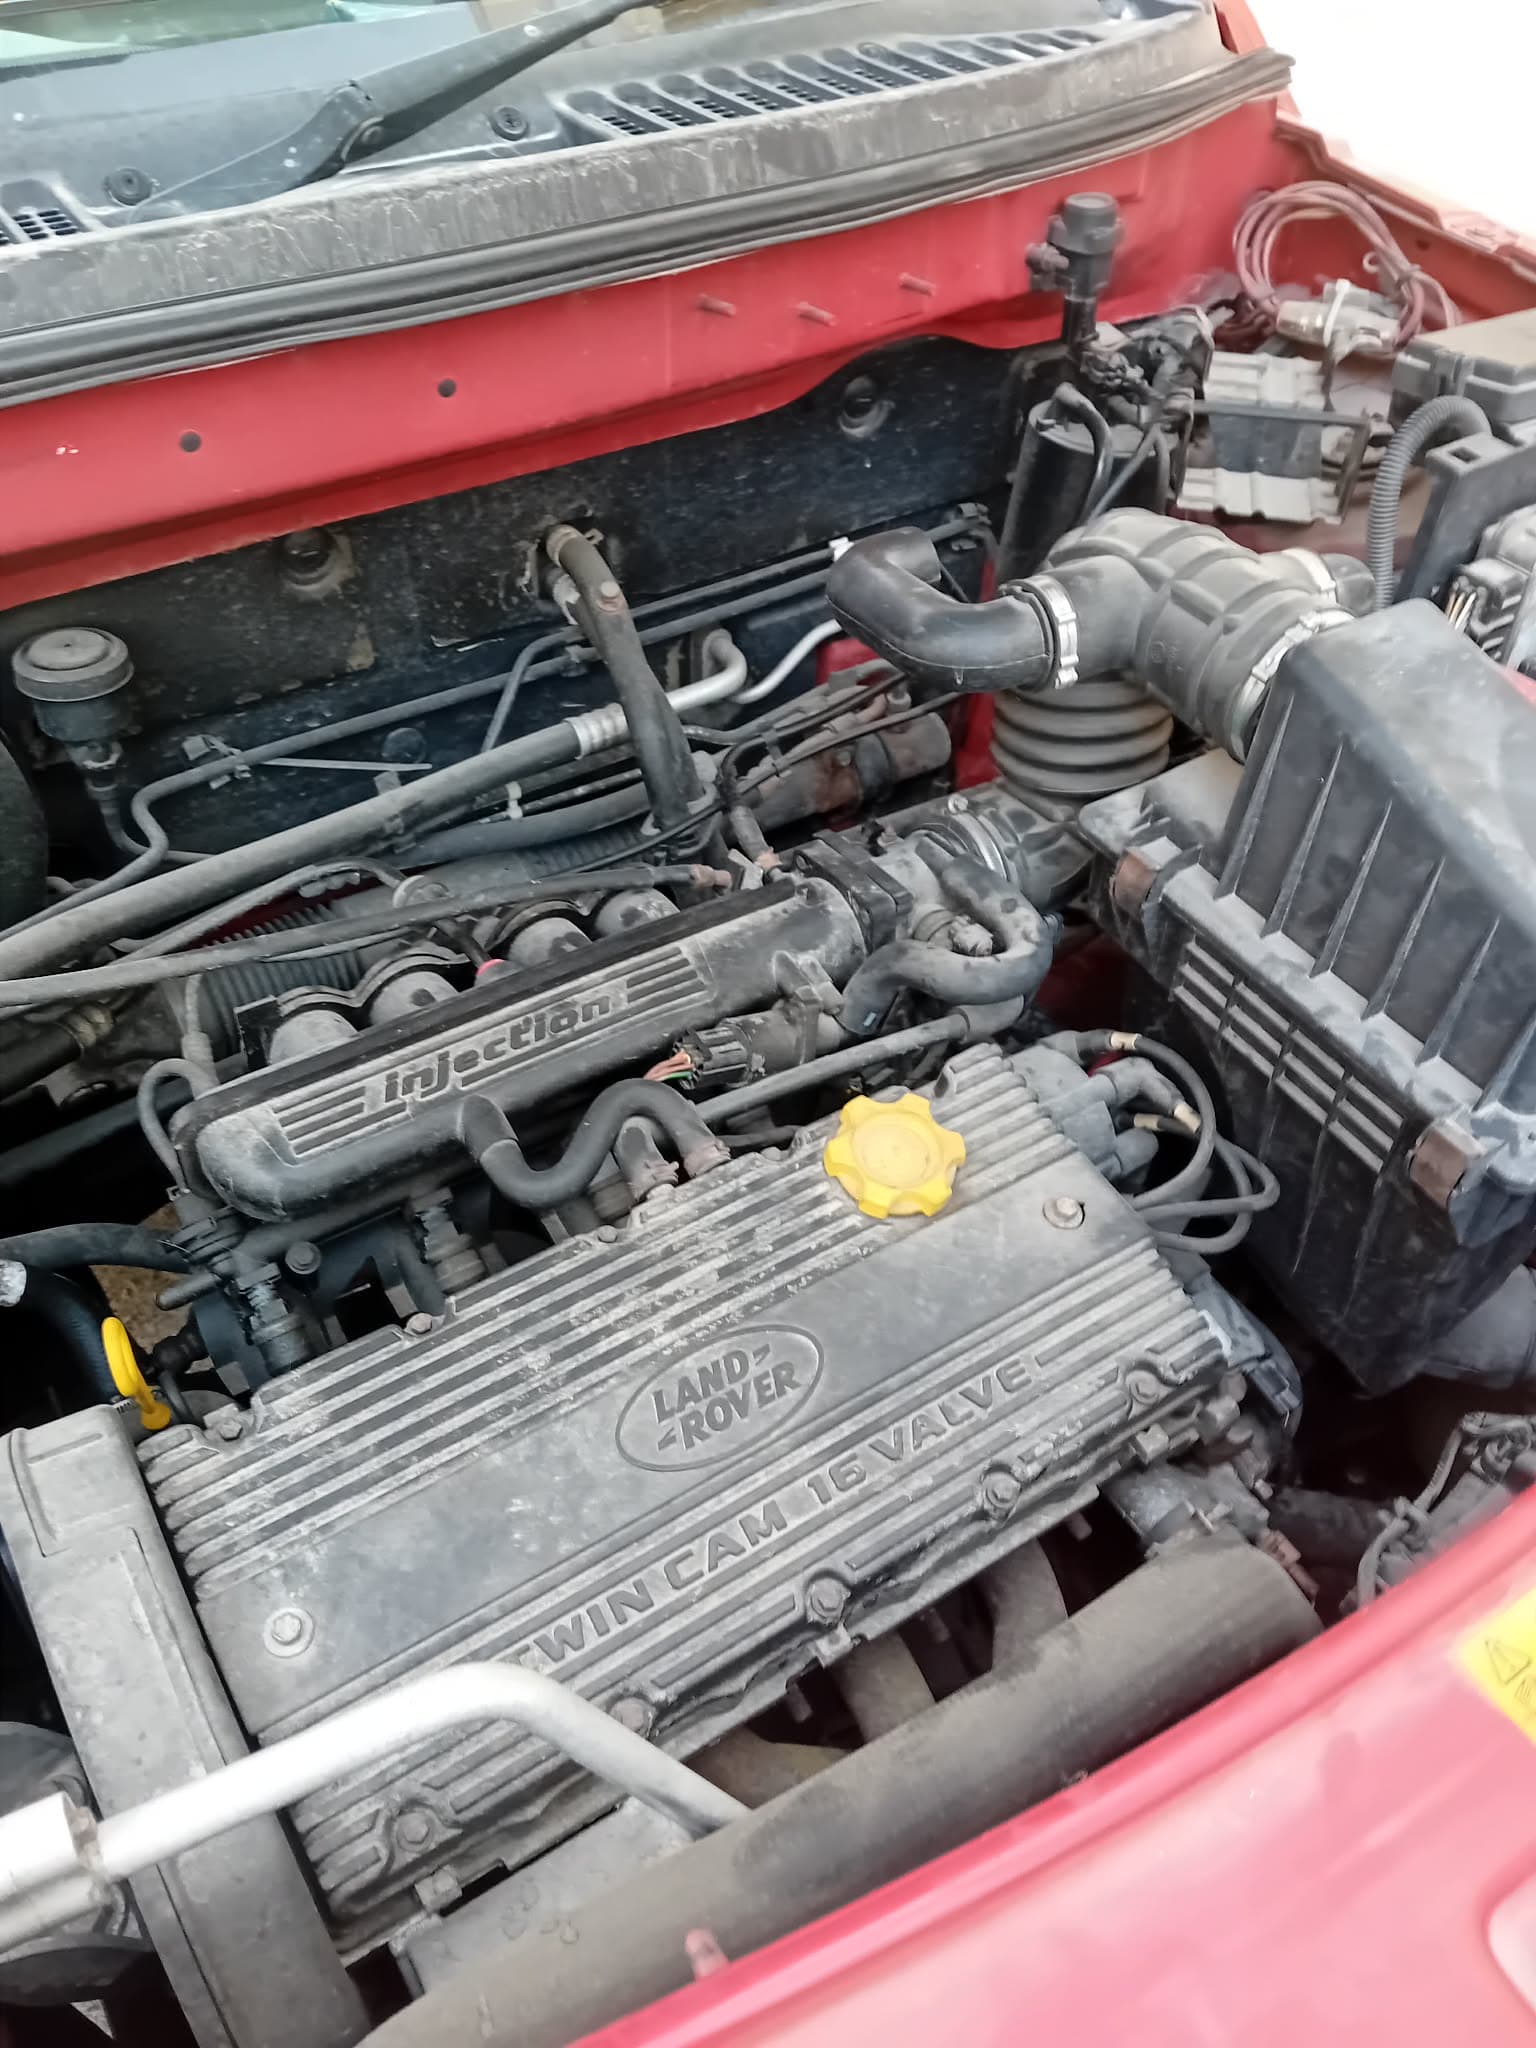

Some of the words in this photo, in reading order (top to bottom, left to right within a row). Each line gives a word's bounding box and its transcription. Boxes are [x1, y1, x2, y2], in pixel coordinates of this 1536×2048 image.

[385, 996, 611, 1103] injection
[652, 1350, 750, 1424] LAND
[680, 1361, 802, 1450] ROVER
[663, 1499, 788, 1590] CAM
[806, 1453, 867, 1505] 16
[868, 1358, 1033, 1462] VALVE
